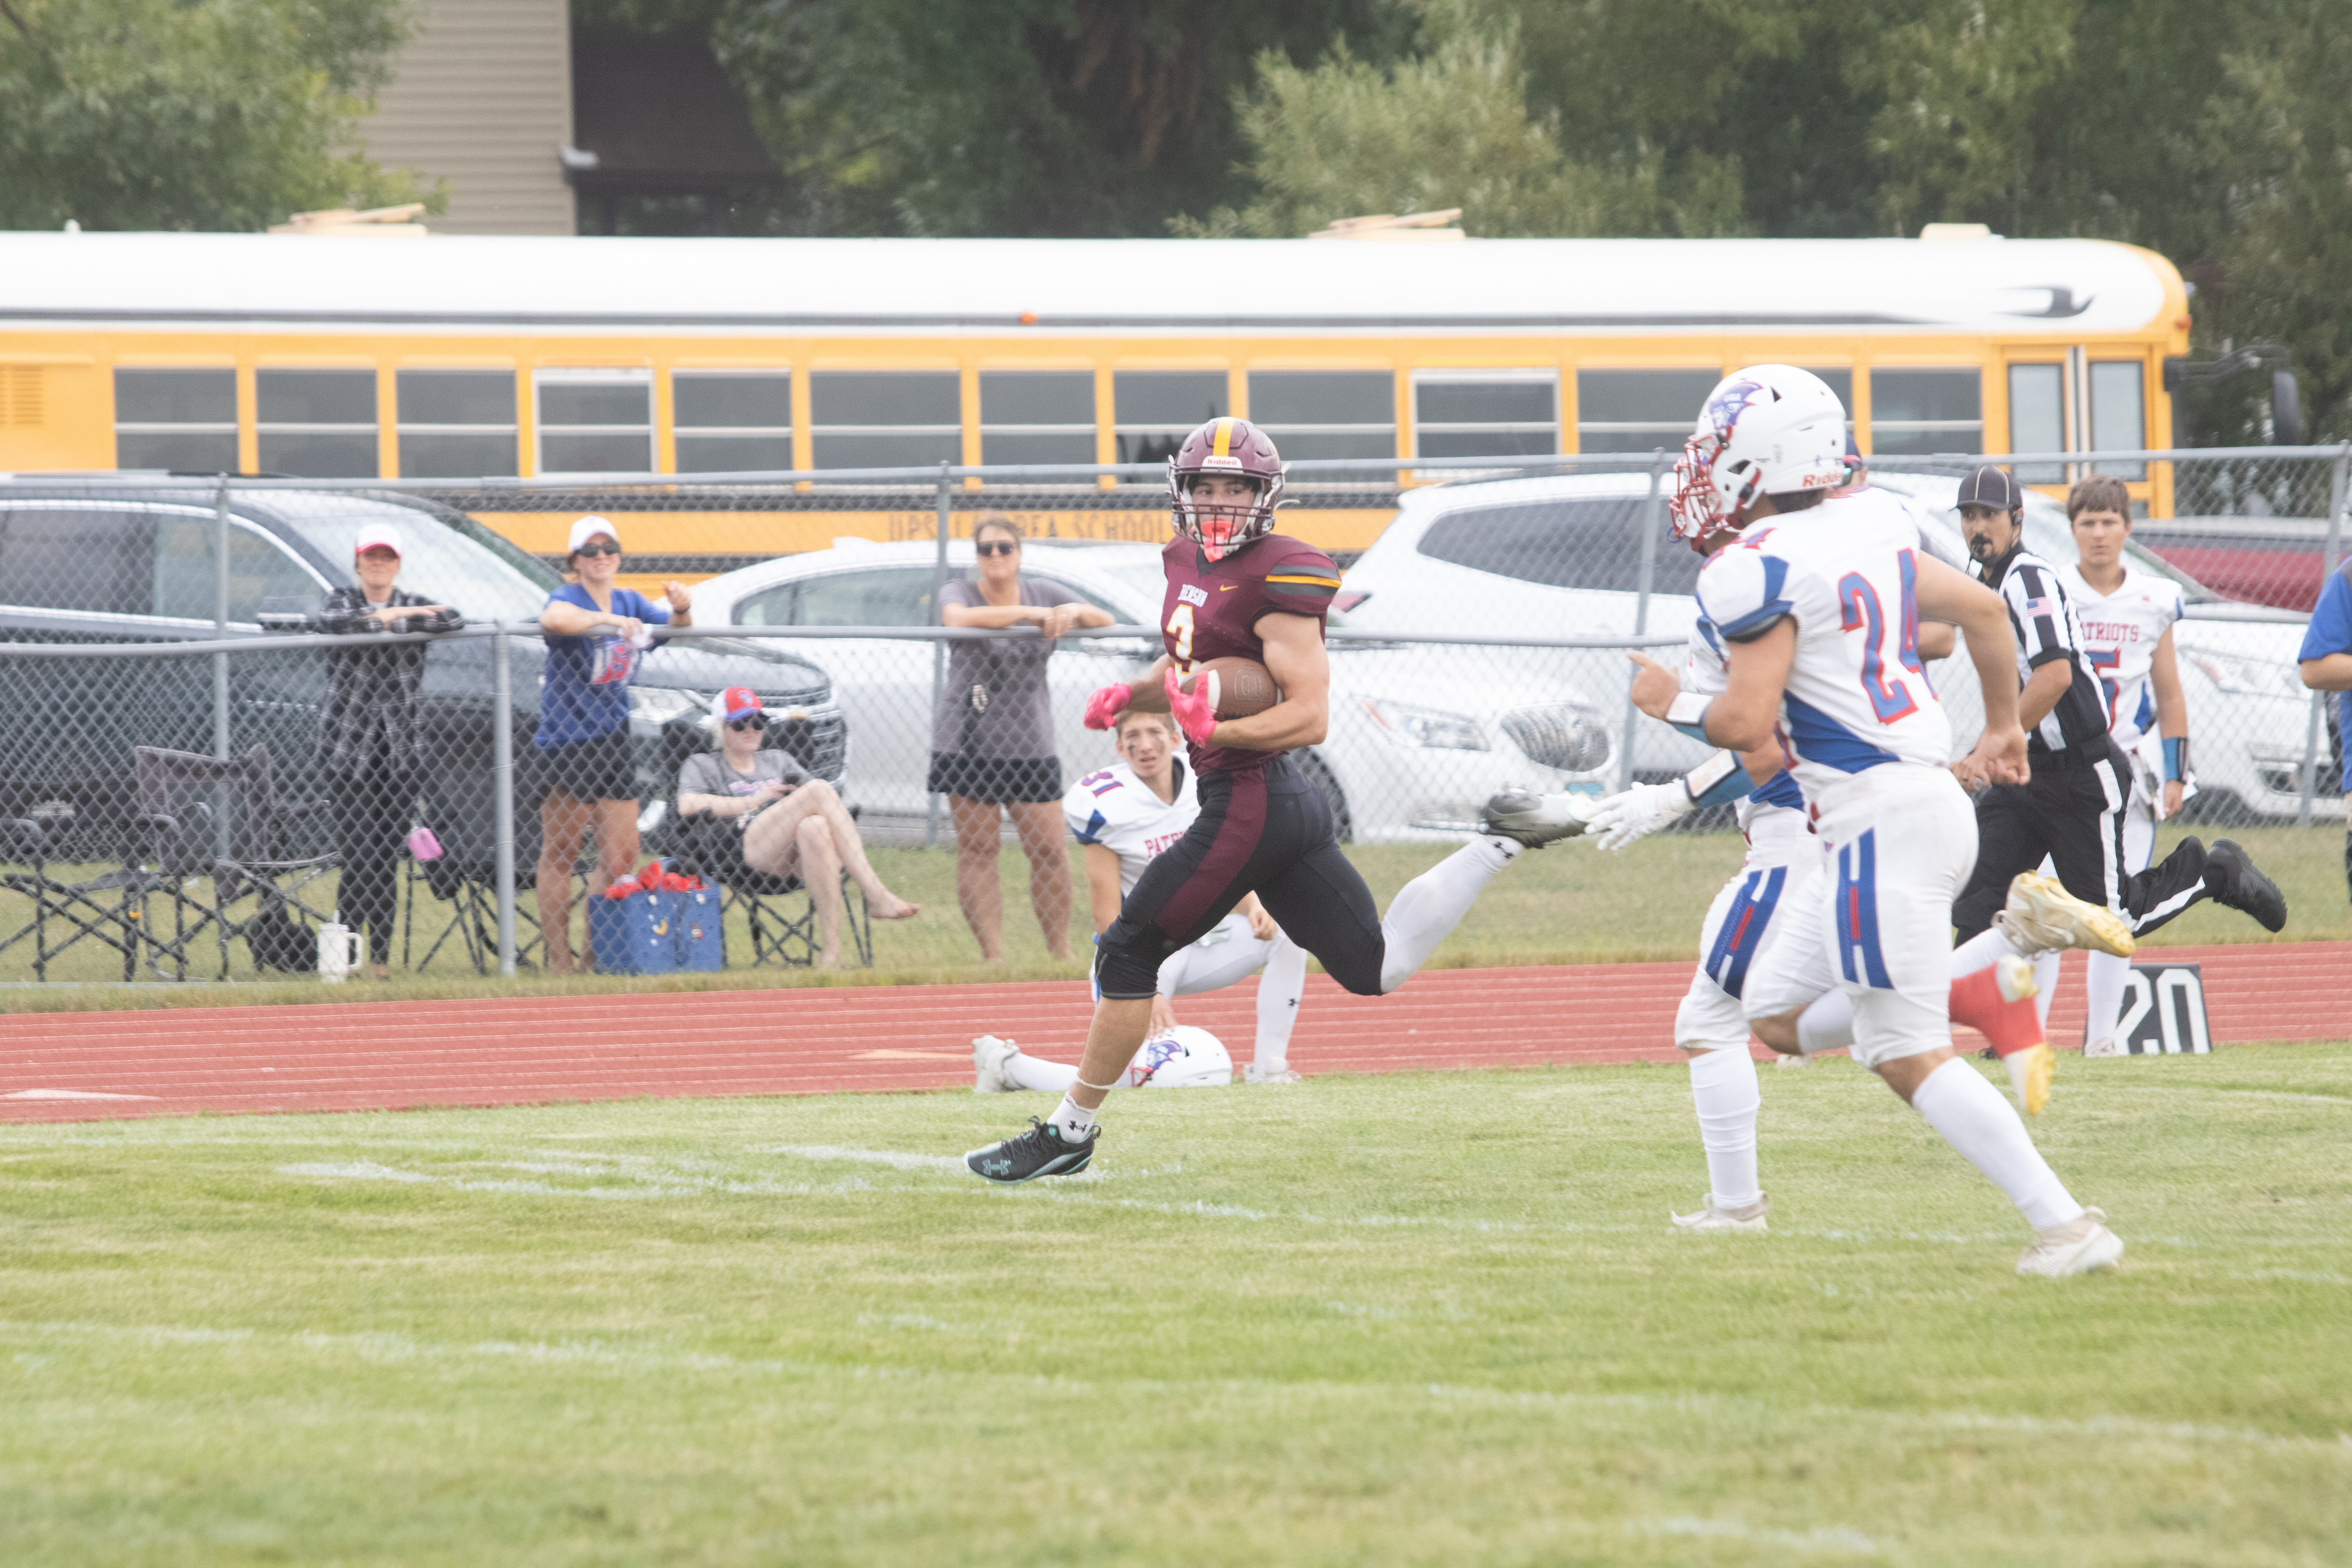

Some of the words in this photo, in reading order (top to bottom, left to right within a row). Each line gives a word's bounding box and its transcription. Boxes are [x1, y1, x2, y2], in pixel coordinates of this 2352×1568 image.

[1178, 583, 1209, 608] BENSON
[1838, 547, 1939, 727] 24
[1167, 604, 1202, 689] 3
[1081, 771, 1125, 799] 31
[2113, 968, 2210, 1054] 20
